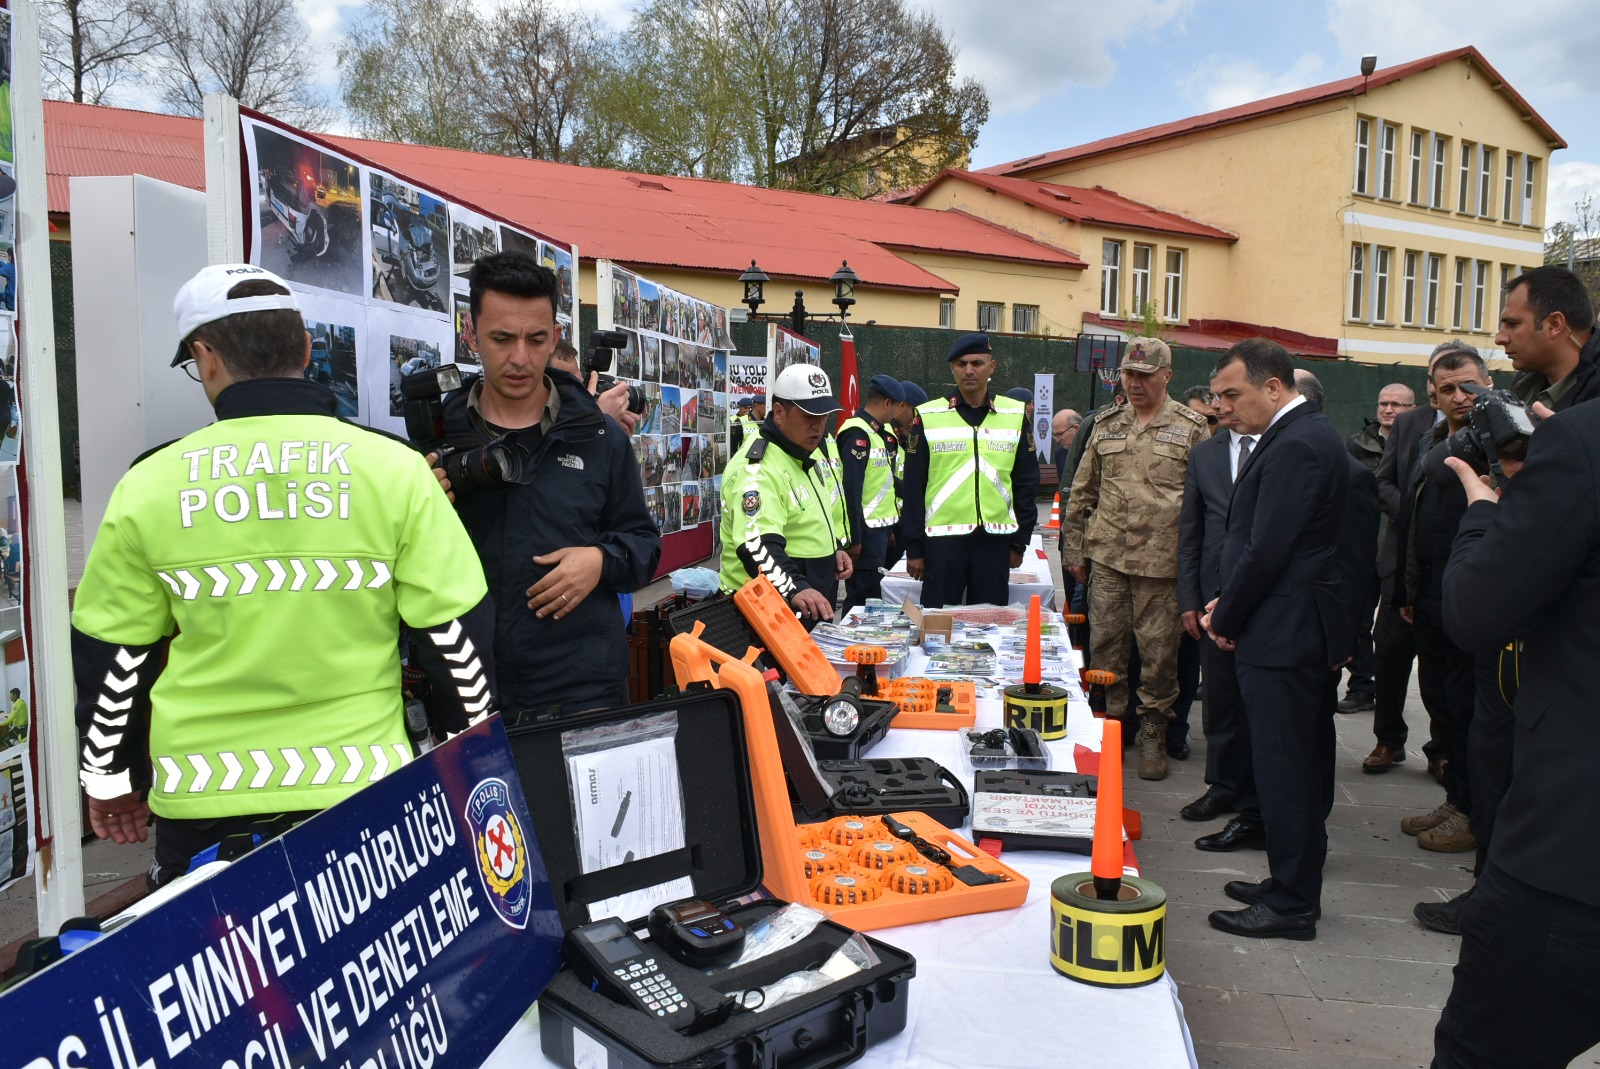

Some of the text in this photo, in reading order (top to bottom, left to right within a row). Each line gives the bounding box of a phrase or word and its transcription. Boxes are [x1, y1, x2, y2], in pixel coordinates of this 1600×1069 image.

[988, 794, 1096, 807] APILMAKTADIR
[982, 807, 1012, 815] SES
[1016, 808, 1035, 816] VE
[1024, 803, 1067, 811] KAYDI
[149, 891, 307, 1059] EMNİYET
[304, 783, 456, 944] MÜDÜRLÜĞÜ
[296, 978, 349, 1062] VE
[342, 867, 480, 1027] DENETLEME
